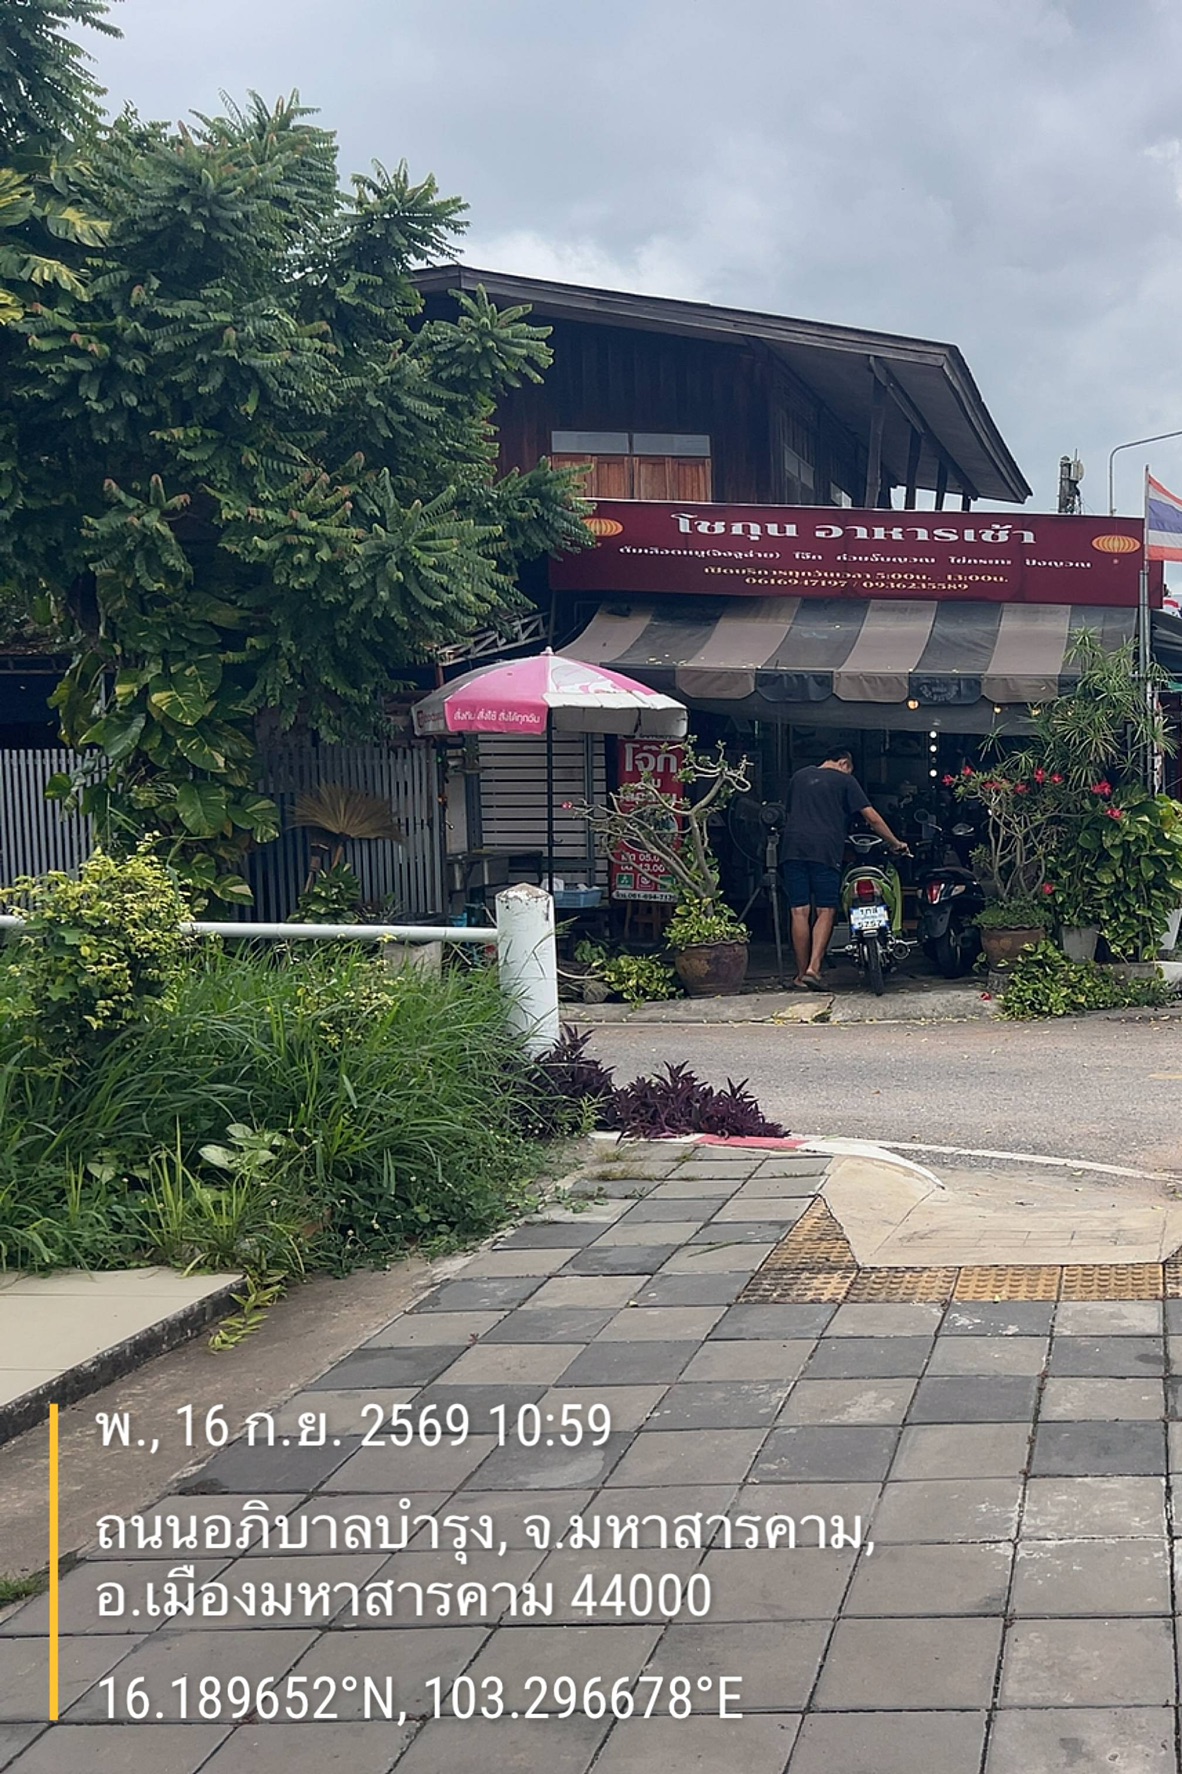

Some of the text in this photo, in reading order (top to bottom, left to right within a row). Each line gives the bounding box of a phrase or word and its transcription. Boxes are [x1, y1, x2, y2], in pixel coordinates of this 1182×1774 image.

[671, 512, 1037, 545] โชกุน อาหารเช้า
[624, 742, 678, 774] โจ๊ก
